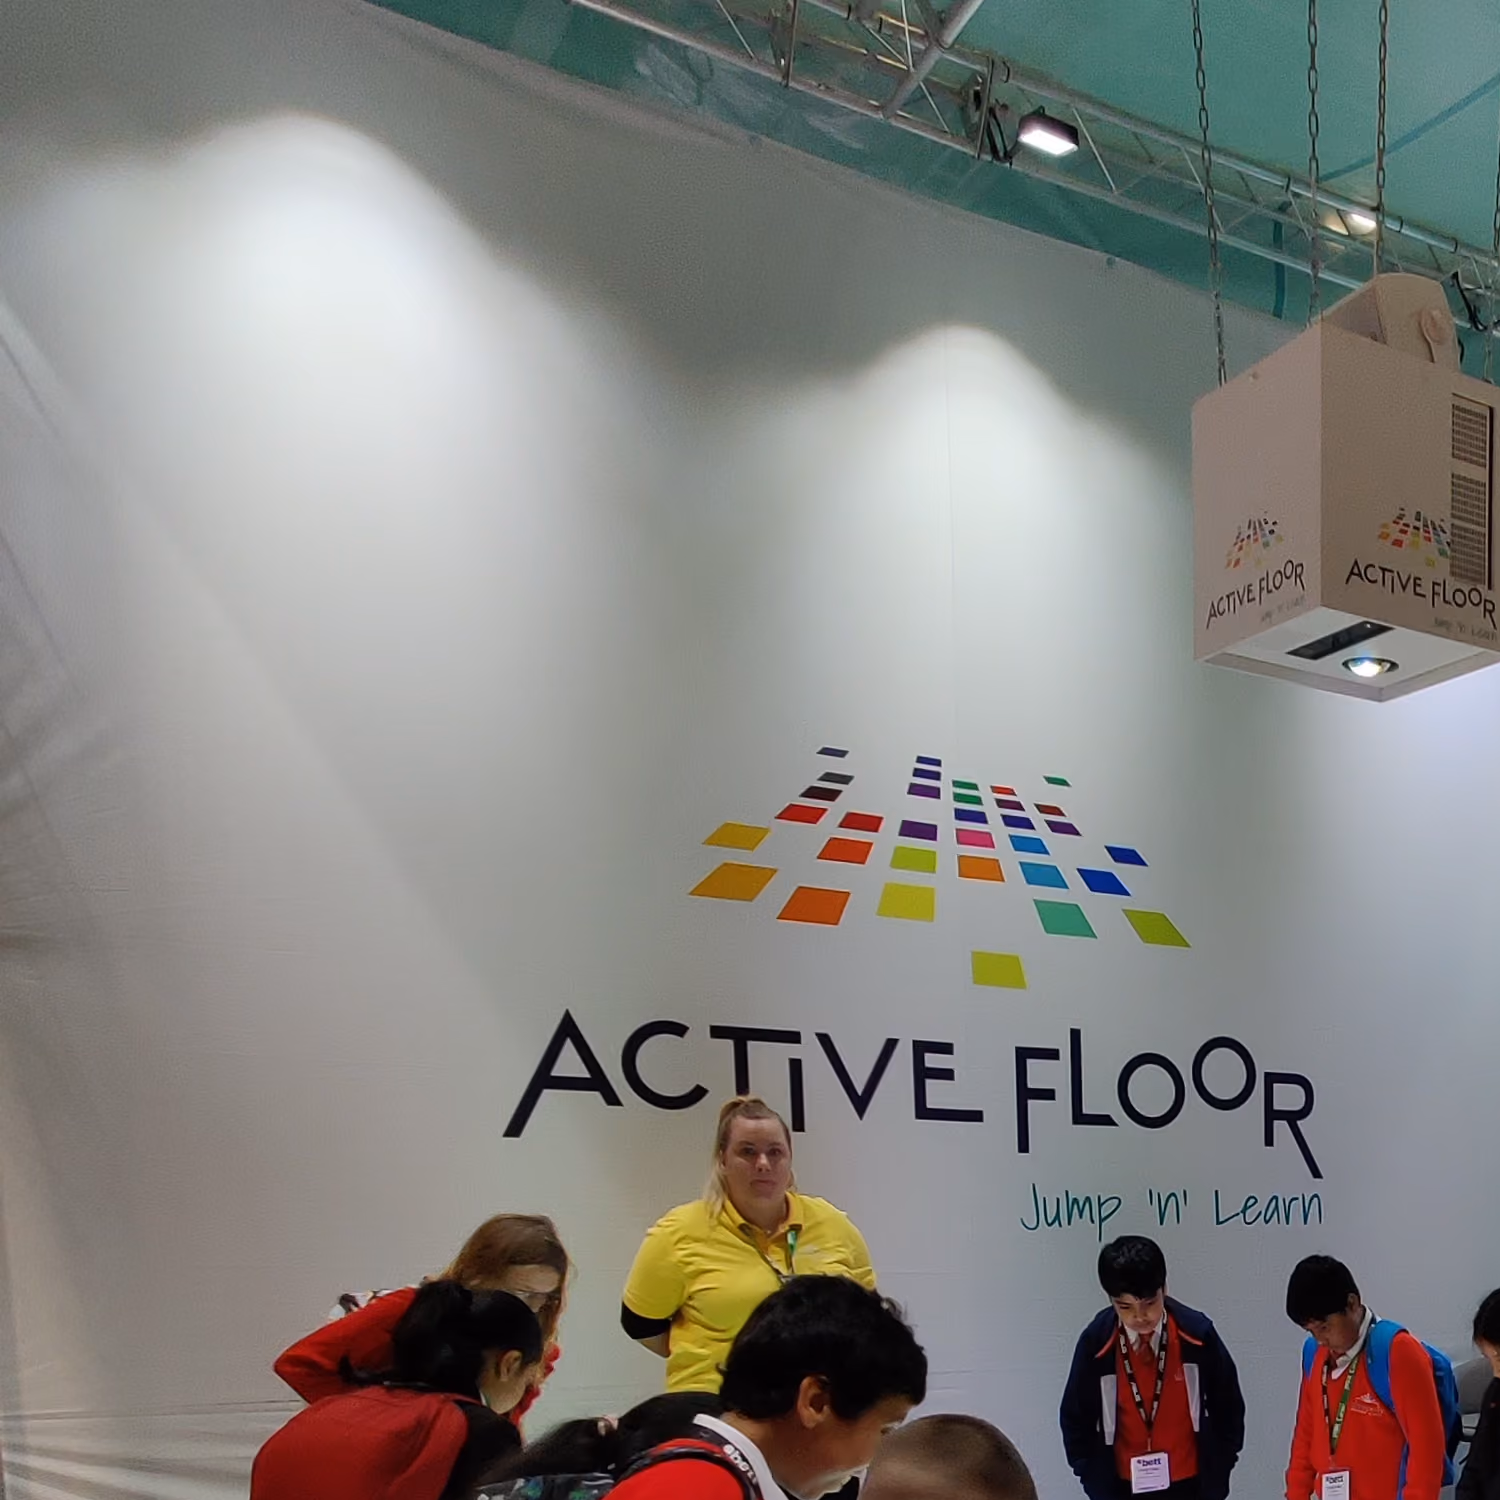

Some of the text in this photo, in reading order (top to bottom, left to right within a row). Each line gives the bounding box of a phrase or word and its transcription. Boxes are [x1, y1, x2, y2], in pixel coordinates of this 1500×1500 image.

[1206, 583, 1256, 629] ACTIVE
[1258, 559, 1305, 606] FLOOR
[1345, 558, 1498, 630] ACTIVE FLOOR
[502, 1009, 1324, 1179] ACTIVE FLOOR
[1019, 1183, 1324, 1241] Jump 'n' Learn
